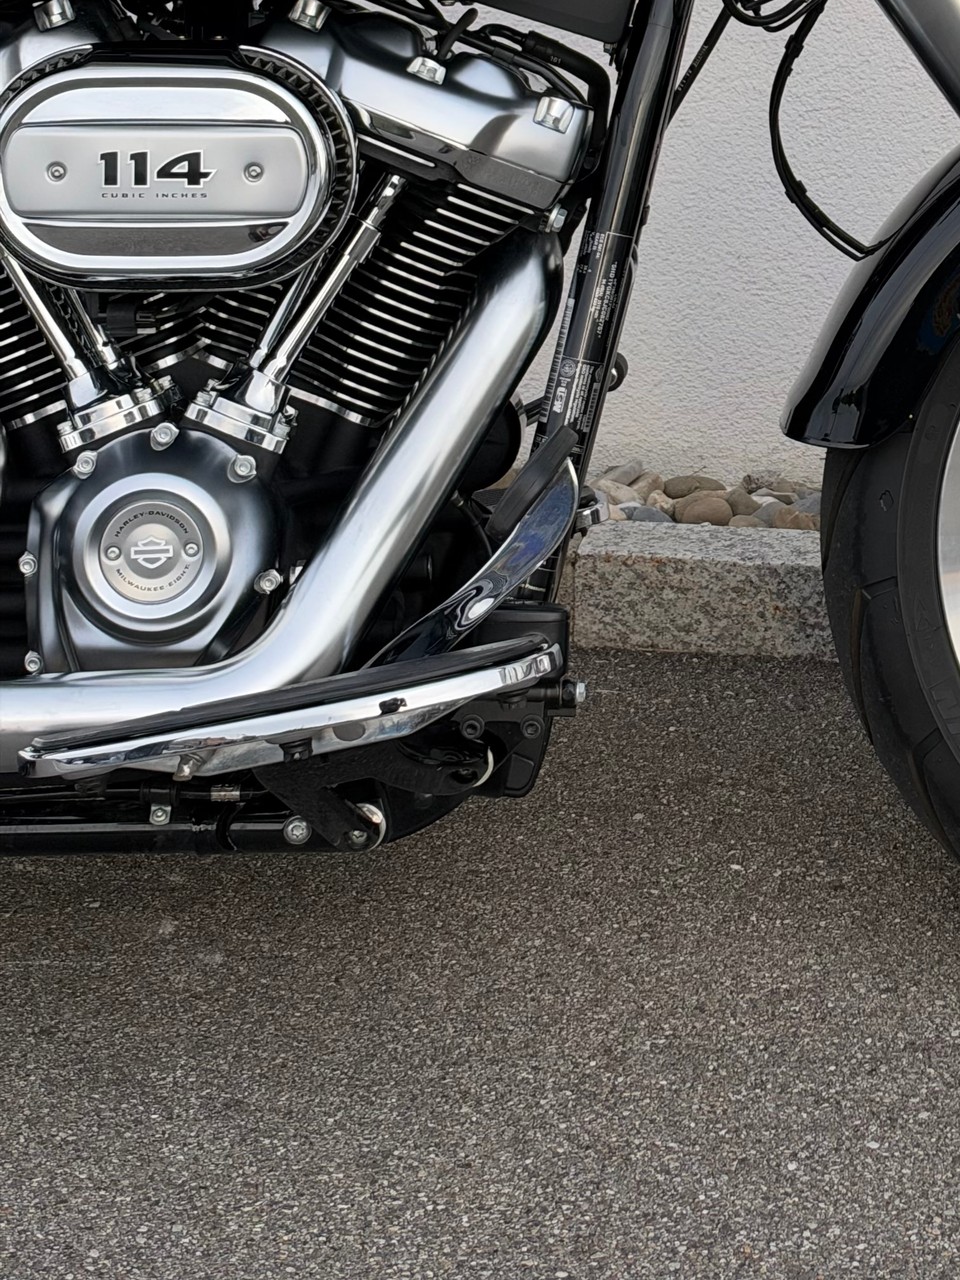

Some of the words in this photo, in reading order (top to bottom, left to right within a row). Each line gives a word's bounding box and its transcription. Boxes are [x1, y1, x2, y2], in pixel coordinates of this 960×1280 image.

[98, 150, 217, 188] 114
[114, 510, 190, 537] HARLEY-DAVIDSON
[116, 565, 190, 592] MILWAUKEE-EIGHT
